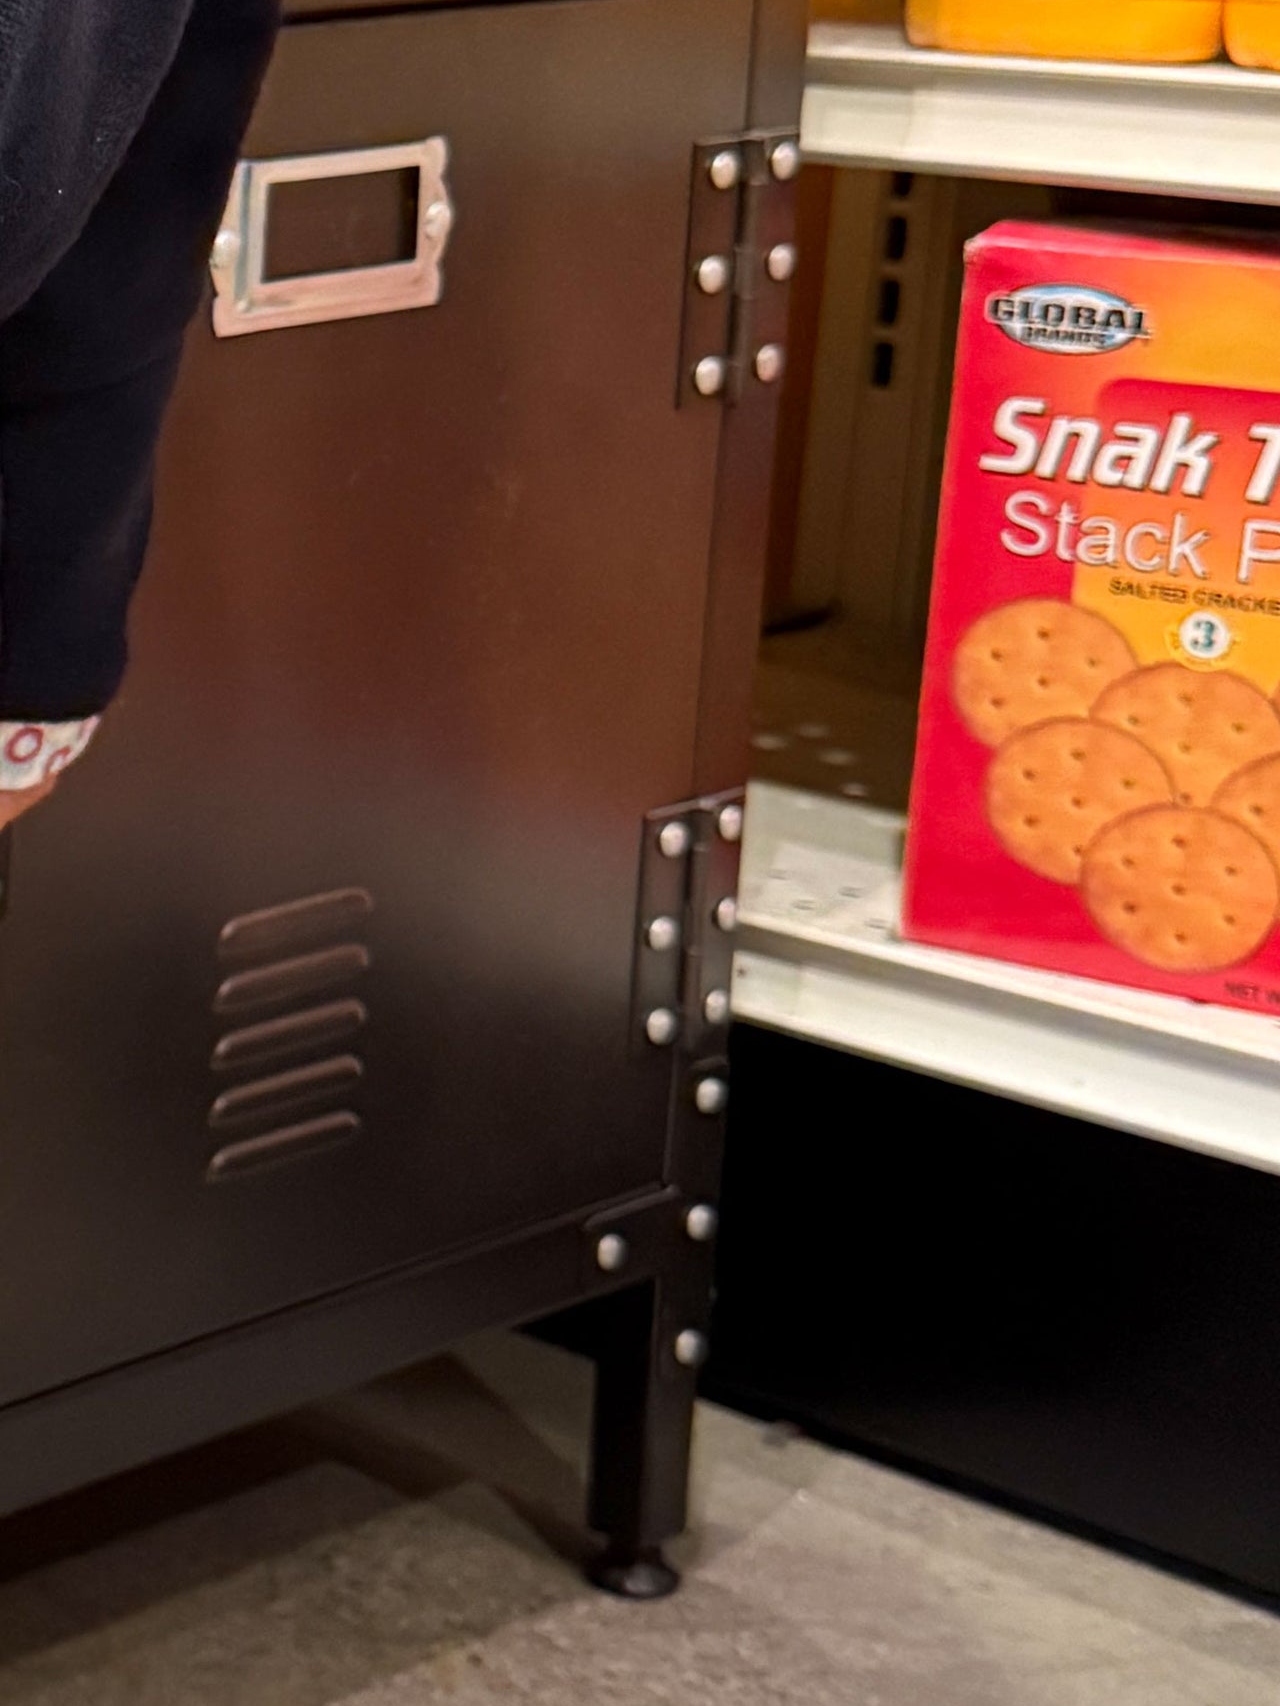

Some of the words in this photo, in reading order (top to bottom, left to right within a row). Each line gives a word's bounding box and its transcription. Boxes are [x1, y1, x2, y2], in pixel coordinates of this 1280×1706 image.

[989, 296, 1151, 337] GLOBAL
[978, 396, 1219, 499] Snak
[1000, 490, 1210, 579] Stack
[1108, 577, 1187, 605] SALTED
[1191, 619, 1217, 651] 3
